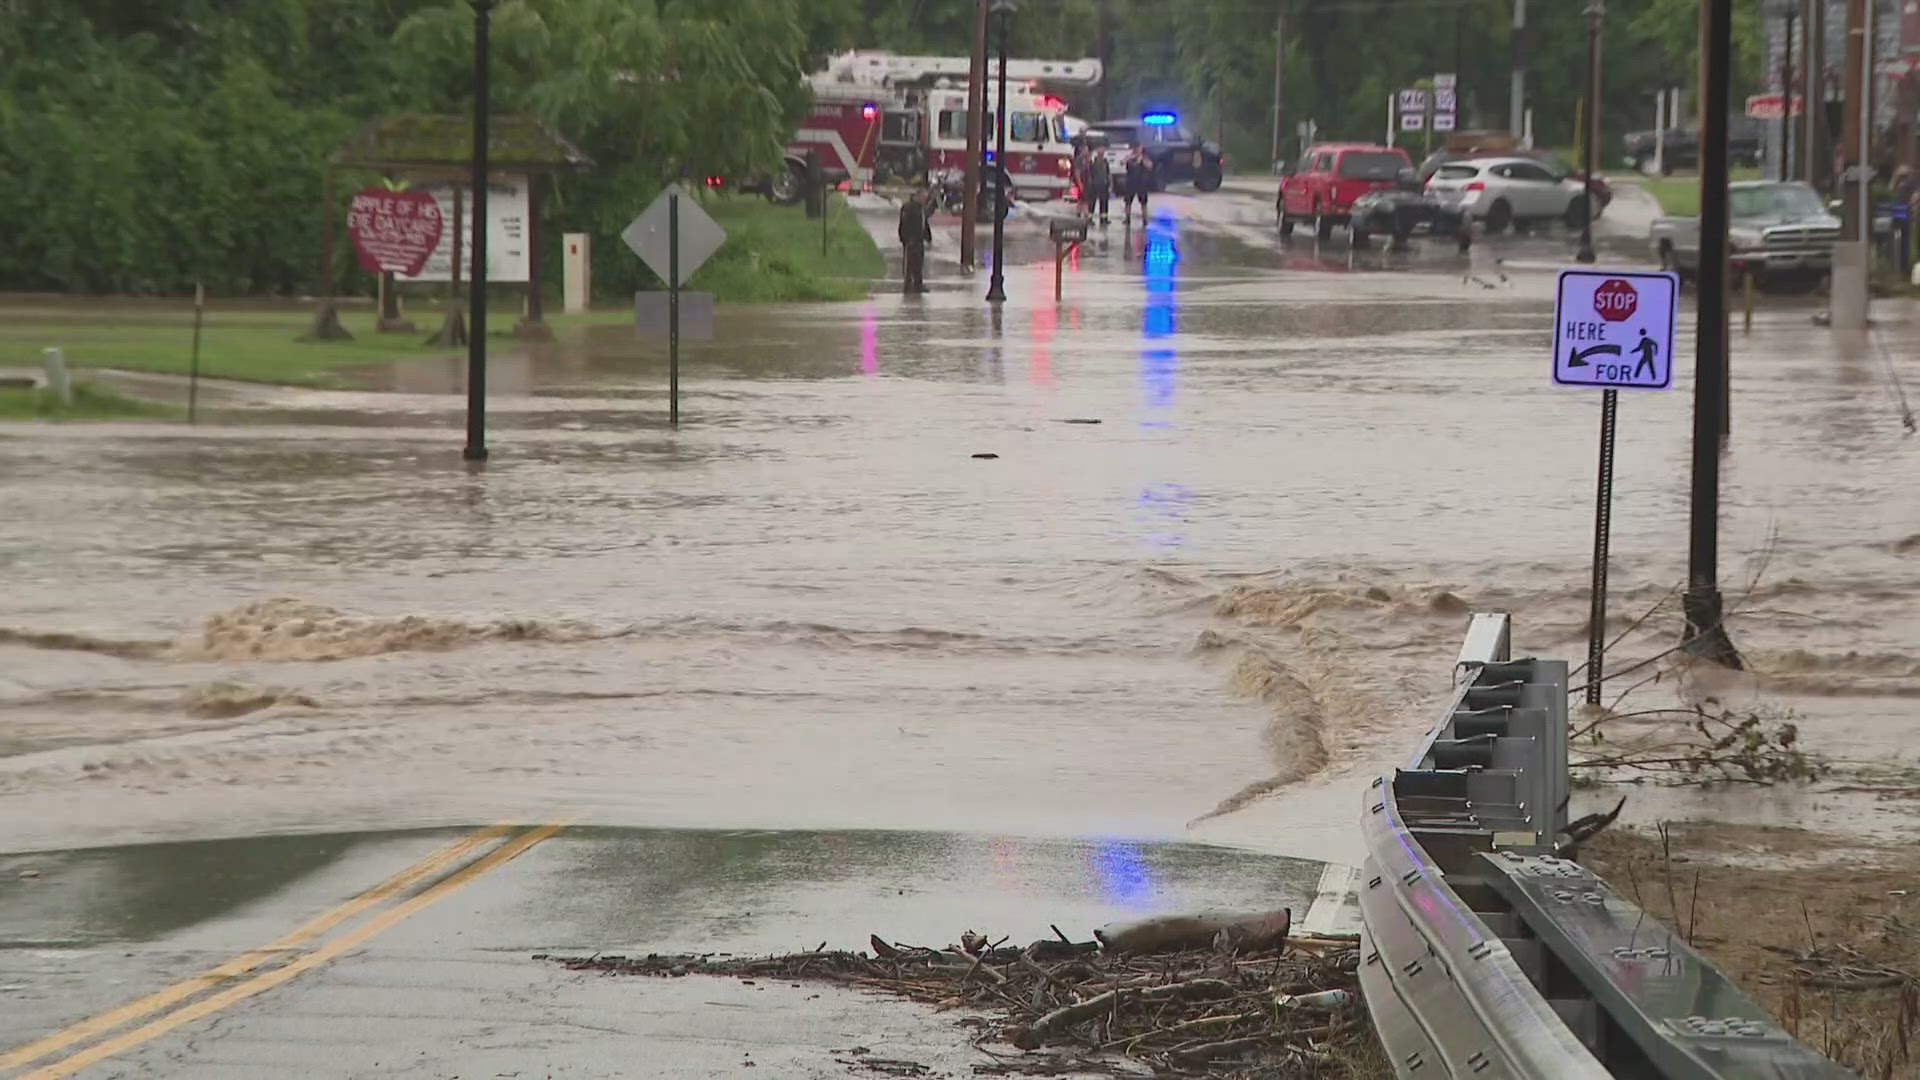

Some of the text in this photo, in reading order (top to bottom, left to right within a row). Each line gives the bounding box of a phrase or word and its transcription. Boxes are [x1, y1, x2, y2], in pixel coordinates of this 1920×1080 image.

[352, 195, 394, 215] APPLE
[396, 199, 416, 216] OF
[346, 210, 371, 229] EYE
[374, 214, 438, 237] DAYCARE
[1595, 291, 1637, 311] STOP
[1566, 321, 1607, 341] HERE
[1595, 364, 1633, 382] FOR
